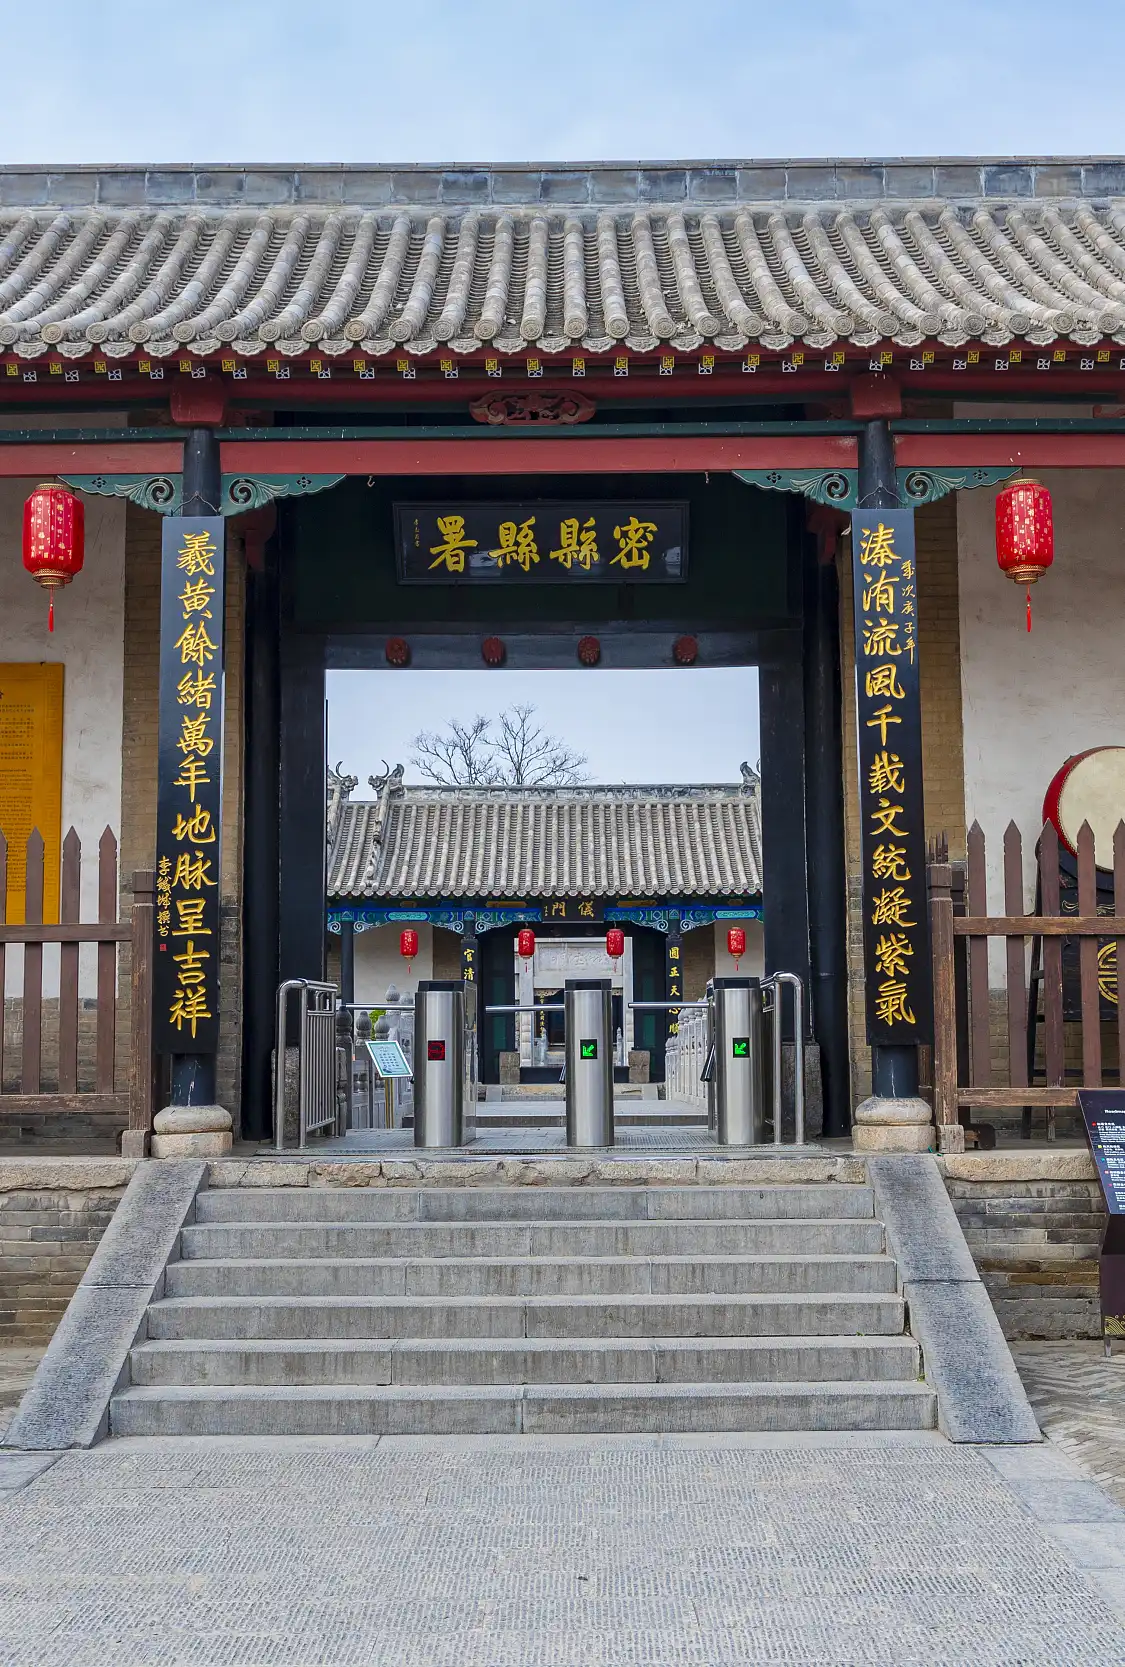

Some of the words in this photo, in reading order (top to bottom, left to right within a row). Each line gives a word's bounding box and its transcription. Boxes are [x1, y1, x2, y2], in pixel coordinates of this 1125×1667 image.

[428, 515, 658, 573] 密縣縣署
[552, 900, 594, 918] 儀門
[463, 948, 475, 981] 官清
